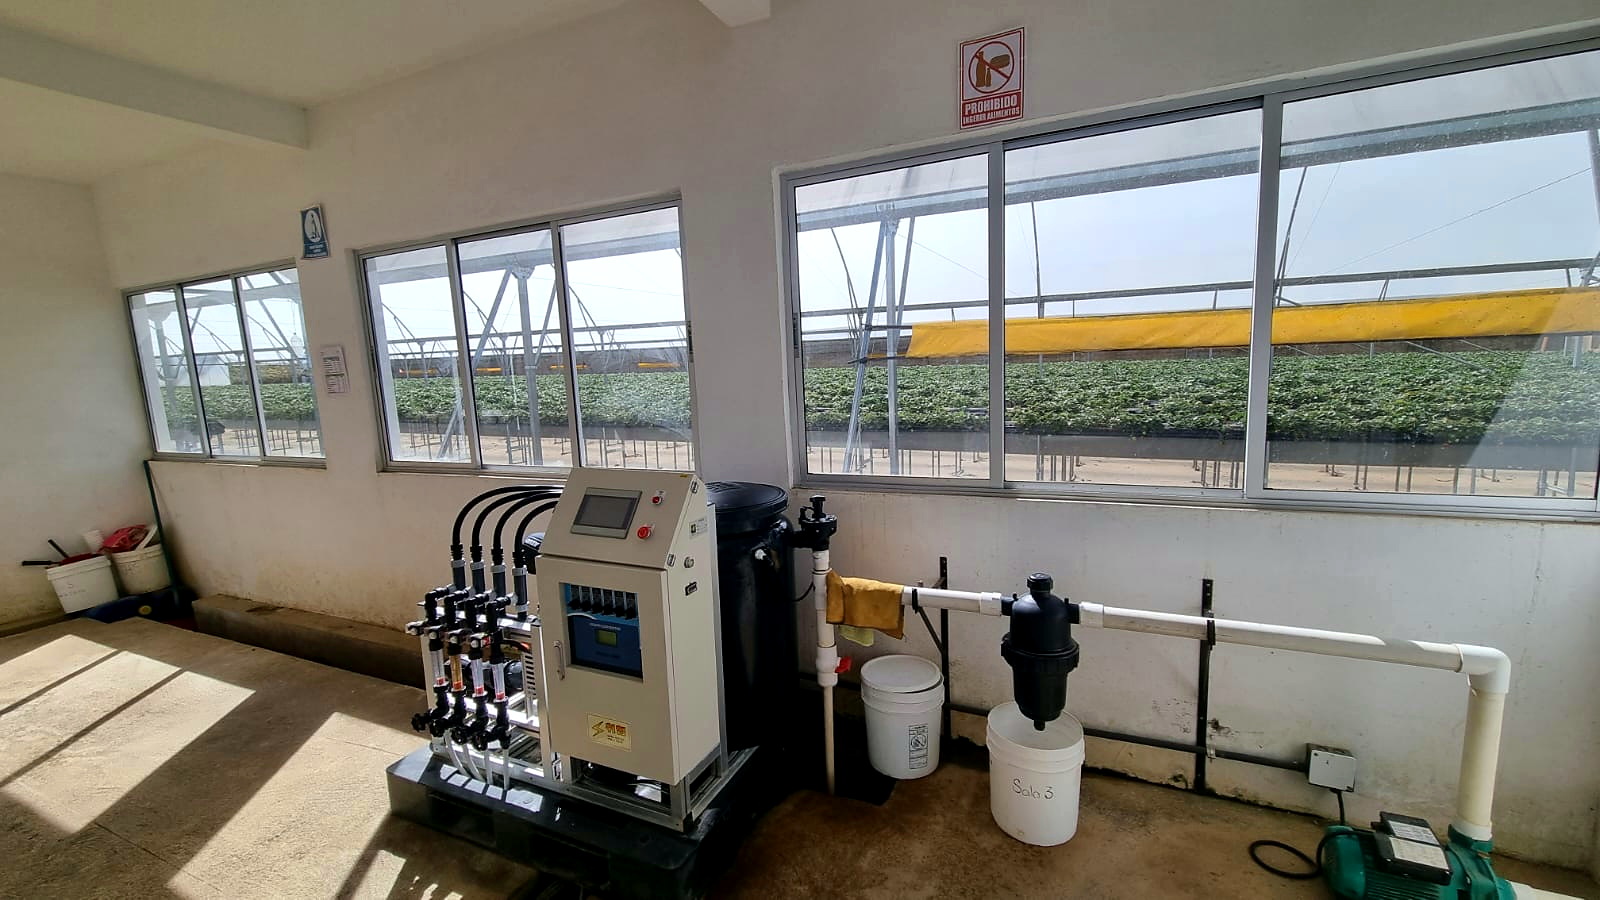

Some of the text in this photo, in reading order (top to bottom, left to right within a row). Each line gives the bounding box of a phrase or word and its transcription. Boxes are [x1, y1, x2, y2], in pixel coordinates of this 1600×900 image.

[965, 95, 1017, 115] PROHIBIDO
[987, 107, 1020, 120] ALIMENTOS
[1045, 786, 1054, 799] 3
